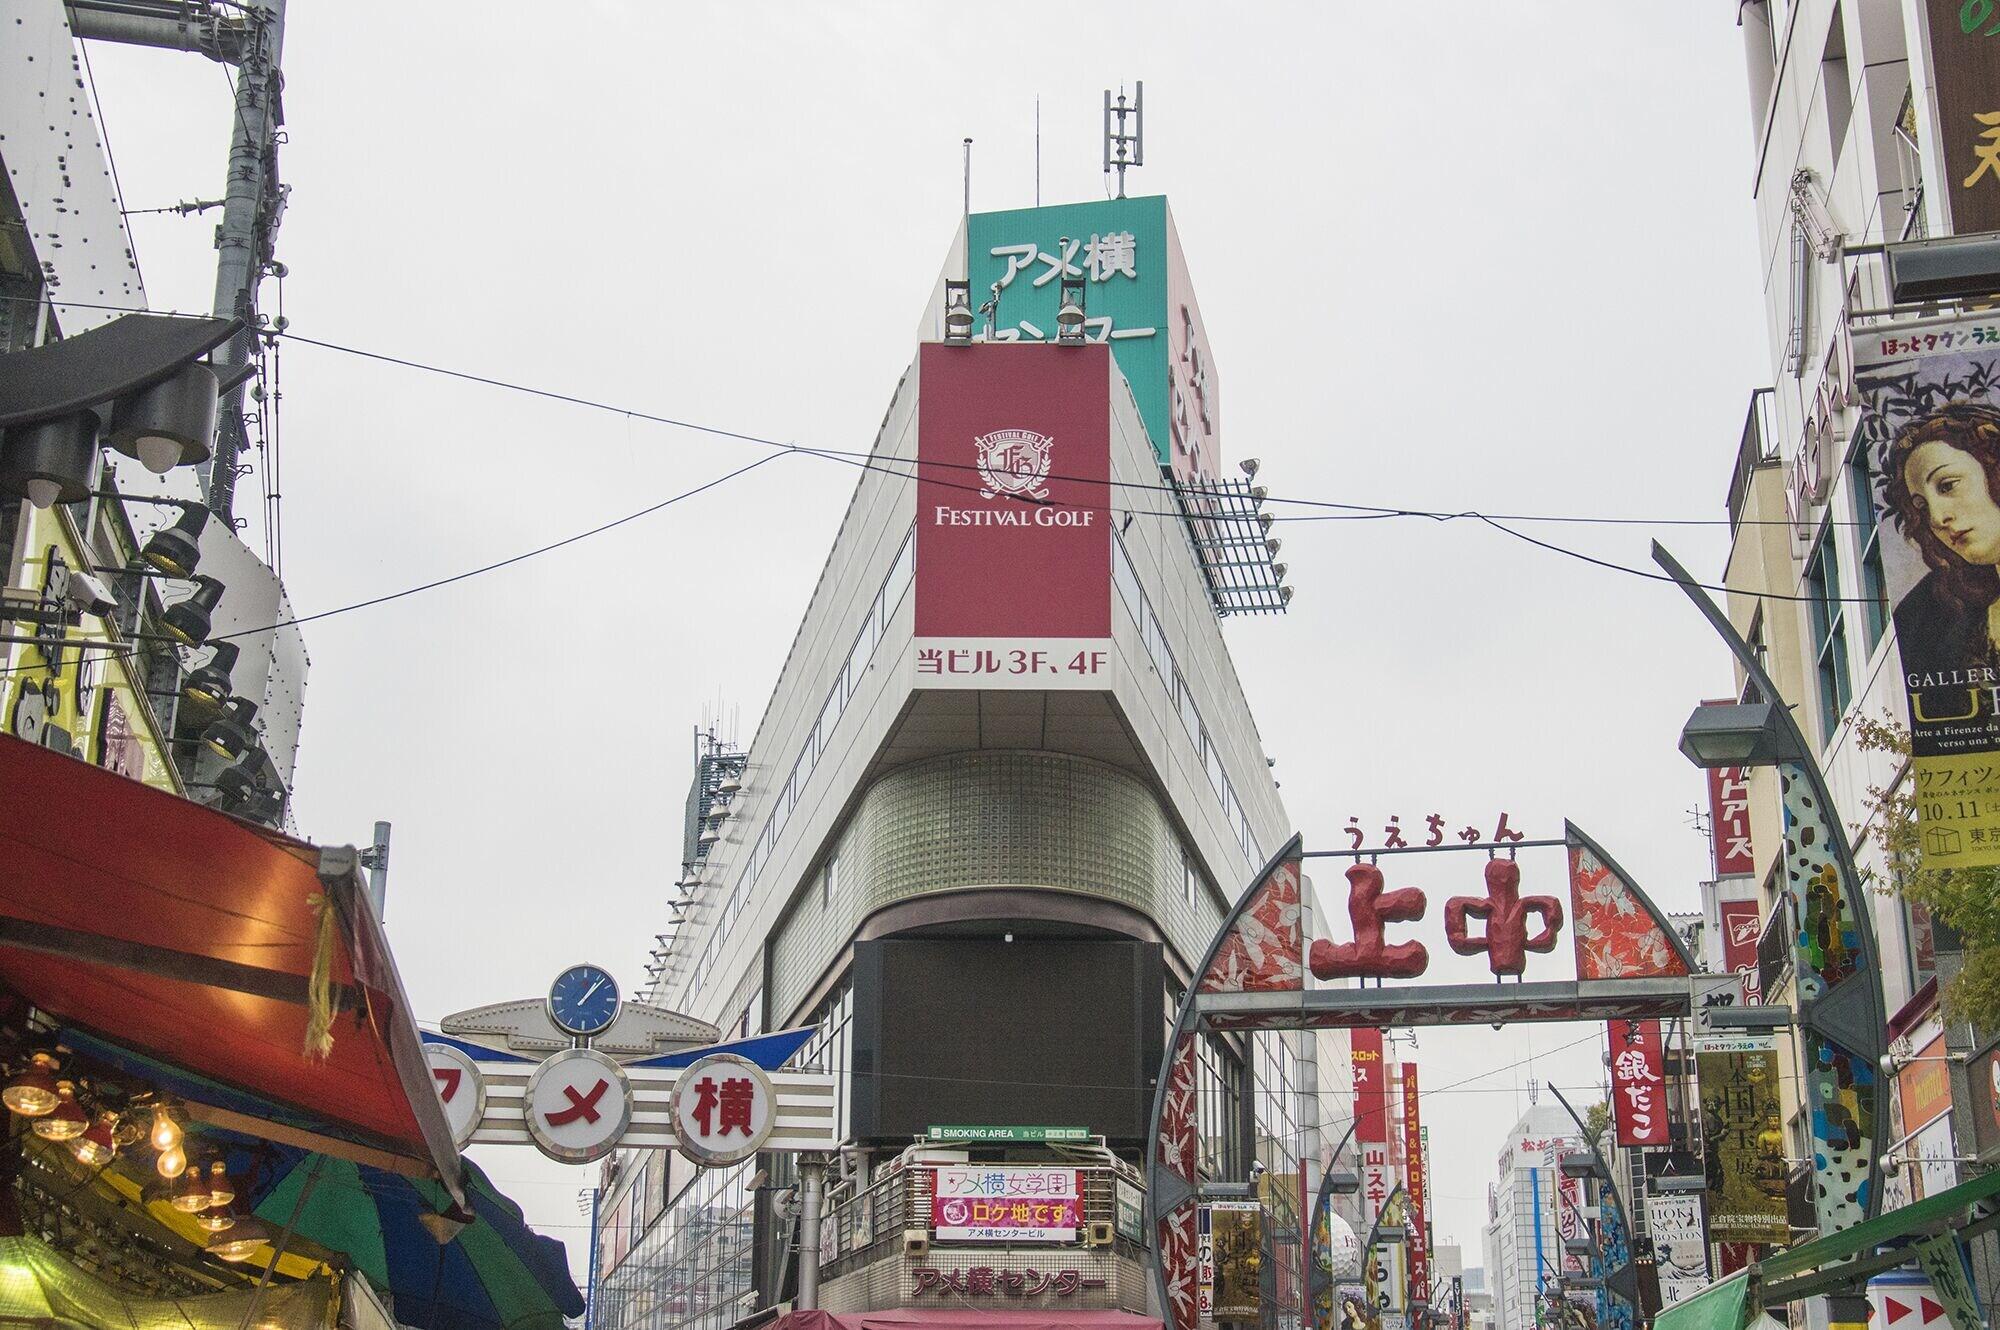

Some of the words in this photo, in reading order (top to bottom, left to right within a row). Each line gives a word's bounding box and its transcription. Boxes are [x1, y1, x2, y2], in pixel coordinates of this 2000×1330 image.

[990, 230, 1137, 291] アメ横
[990, 431, 1020, 443] FESTIVAL
[1022, 431, 1039, 442] GOLF
[935, 506, 1031, 527] FESTIVAL
[1034, 509, 1093, 527] GOLF
[1907, 667, 2000, 688] GALLER
[1914, 729, 1933, 738] Arte
[1935, 729, 1941, 737] a
[1944, 726, 1983, 736] Firenze
[1986, 723, 1999, 733] da
[1938, 740, 1965, 748] verso
[1344, 812, 1524, 850] うえちゅん
[1309, 857, 1564, 981] 上中
[943, 1129, 986, 1138] SMOKING
[987, 1129, 1014, 1138] AREA
[947, 1172, 1067, 1195] アメ横女学園
[973, 1204, 1067, 1223] ロケ地です
[968, 1228, 1045, 1238] アメ横センタービル
[912, 1266, 1107, 1297] アメ横センター
